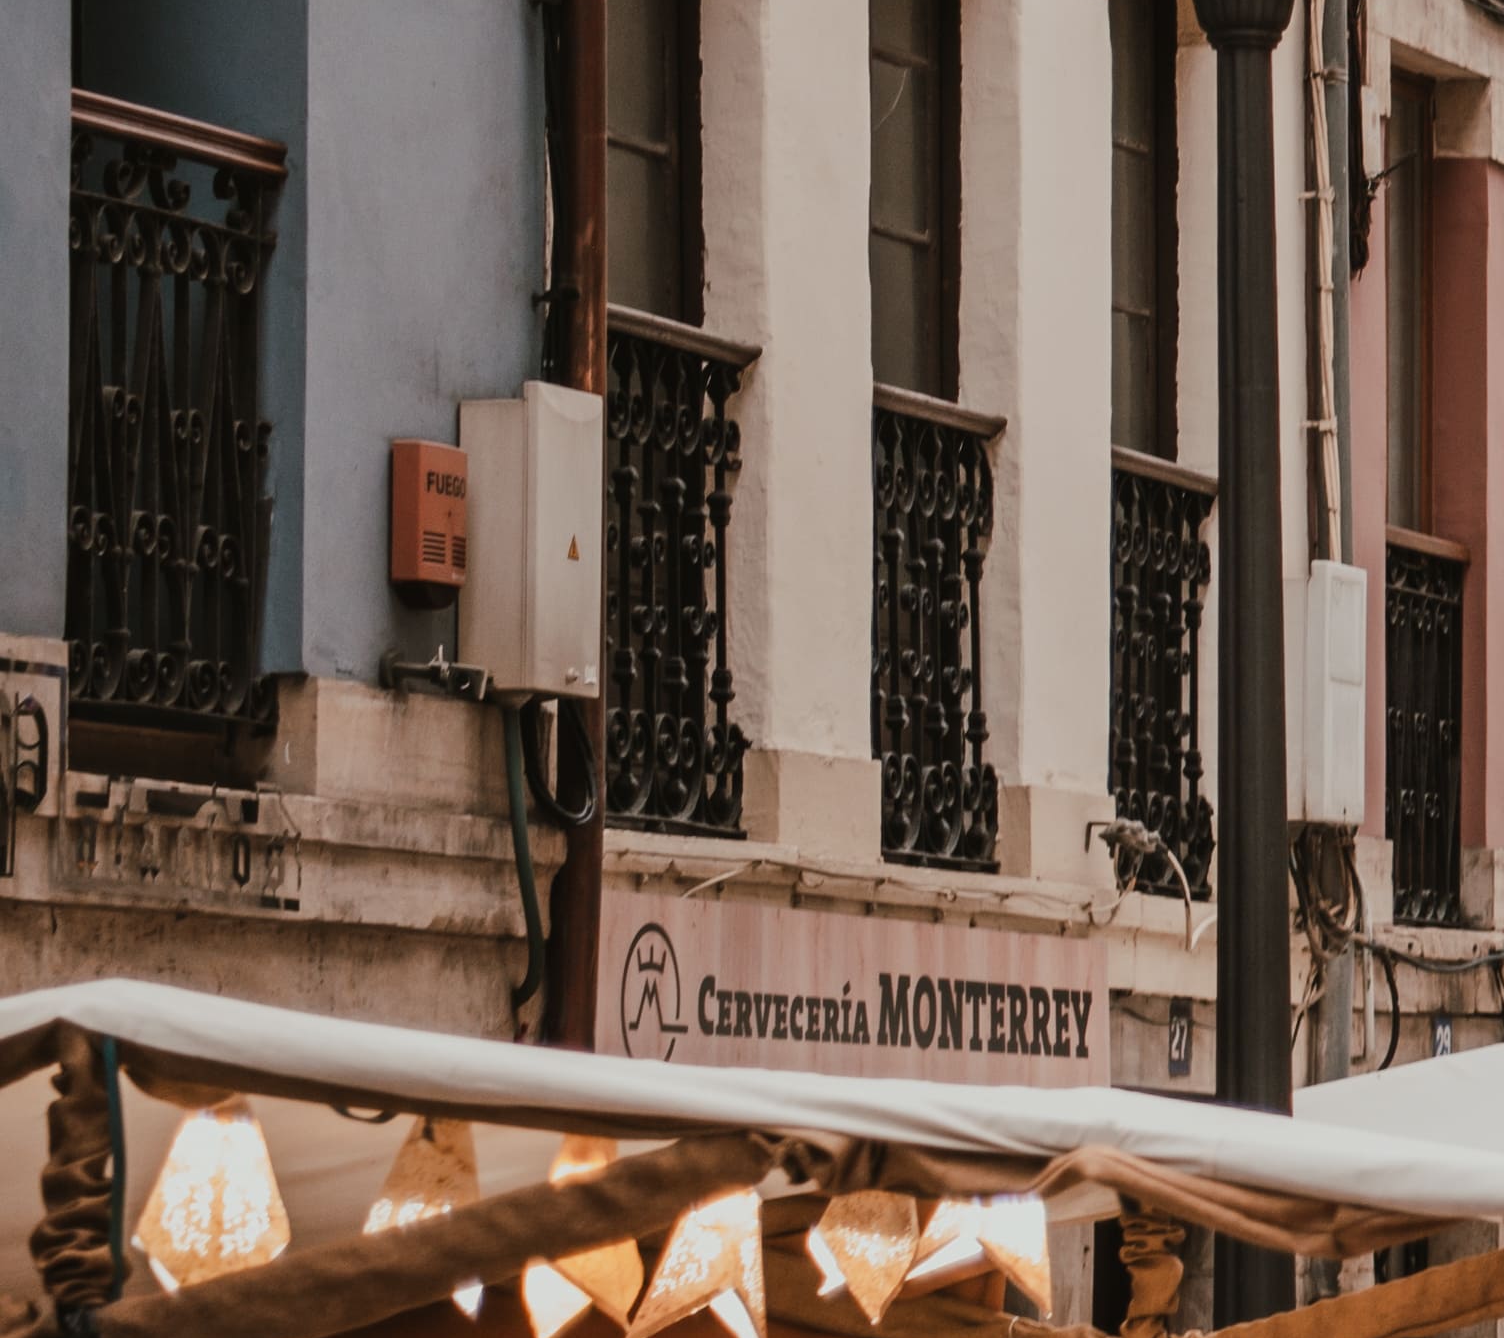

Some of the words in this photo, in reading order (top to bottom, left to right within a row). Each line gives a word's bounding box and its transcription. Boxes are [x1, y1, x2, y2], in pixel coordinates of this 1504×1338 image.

[426, 471, 466, 499] FUEGO
[876, 973, 1092, 1059] MONTERREY
[1171, 1015, 1187, 1061] 27
[1435, 1024, 1451, 1057] 29
